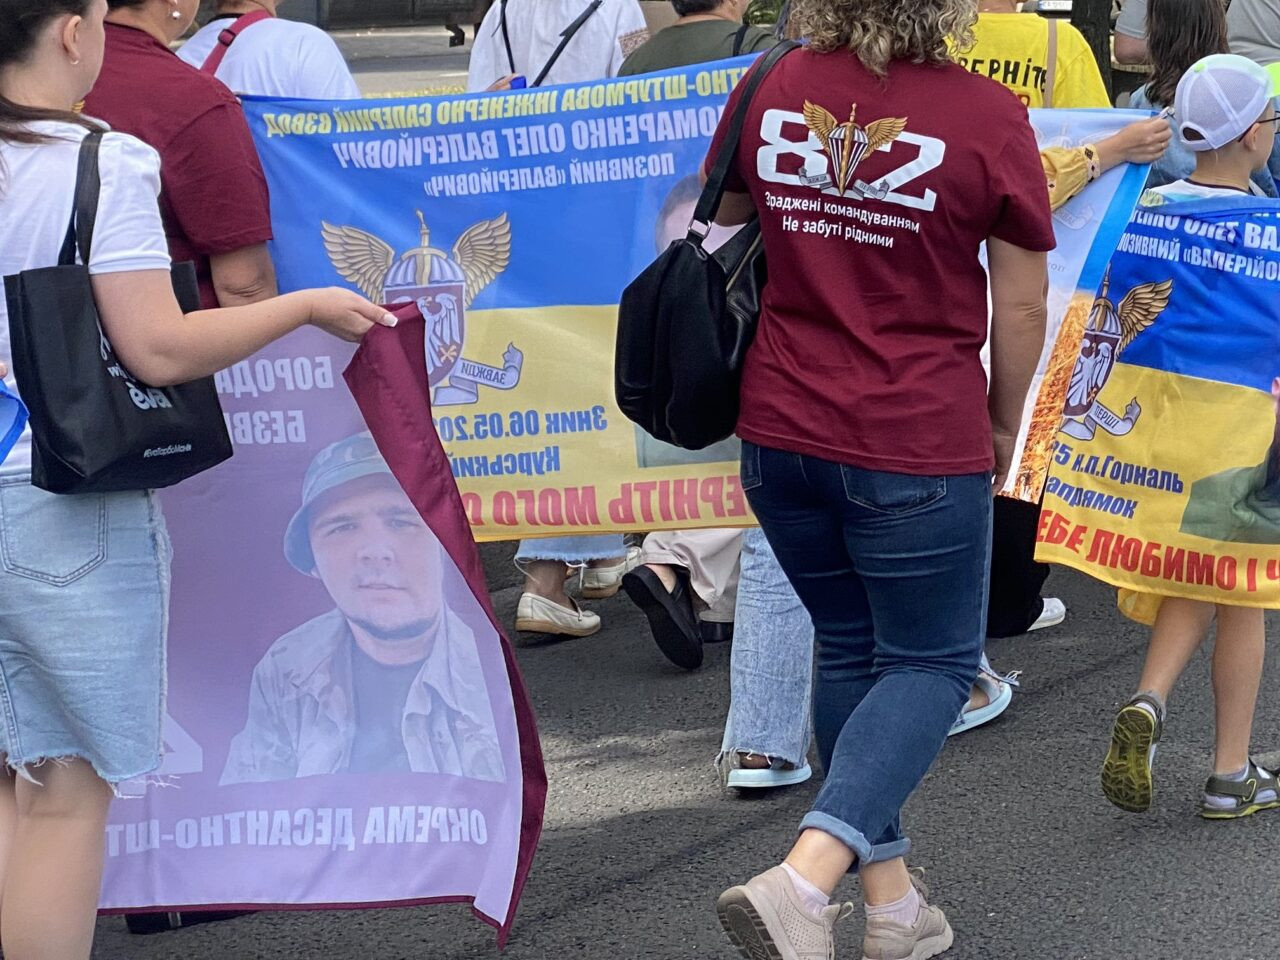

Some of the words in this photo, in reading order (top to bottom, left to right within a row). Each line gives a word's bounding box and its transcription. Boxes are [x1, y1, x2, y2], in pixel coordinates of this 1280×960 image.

[757, 109, 946, 212] 82
[764, 191, 821, 214] Зраджені
[823, 201, 921, 234] командуванням
[782, 215, 799, 232] Не
[802, 219, 842, 239] забуті
[844, 225, 894, 249] рідними
[1094, 402, 1120, 429] ПЕРШІ
[1046, 475, 1139, 519] апрямок
[1086, 527, 1237, 591] ЛЮБИМО
[1246, 557, 1258, 592] І
